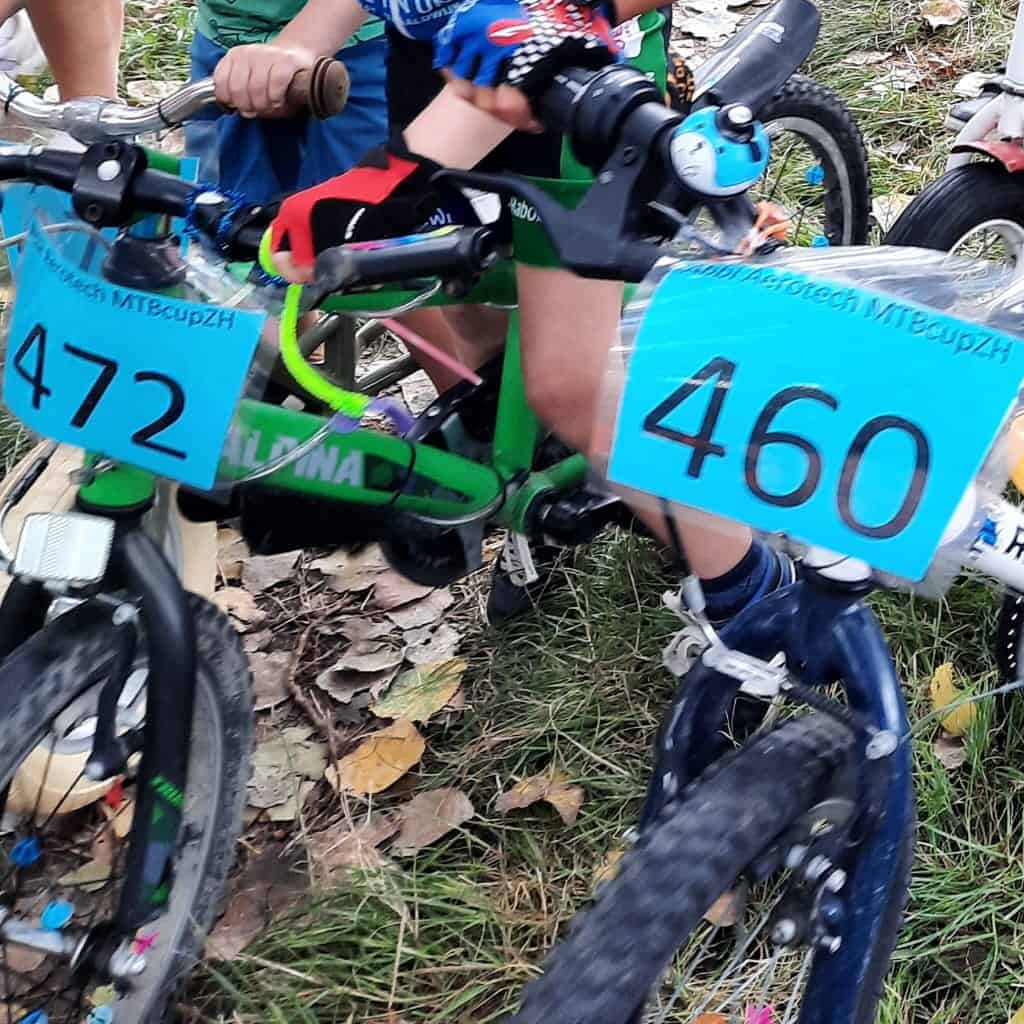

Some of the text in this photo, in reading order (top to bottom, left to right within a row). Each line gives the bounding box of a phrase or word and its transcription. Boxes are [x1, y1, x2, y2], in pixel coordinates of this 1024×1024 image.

[111, 290, 235, 329] MTBcupZH
[863, 296, 1014, 365] MTBcupZH
[13, 322, 187, 460] 472
[642, 355, 931, 540] 460
